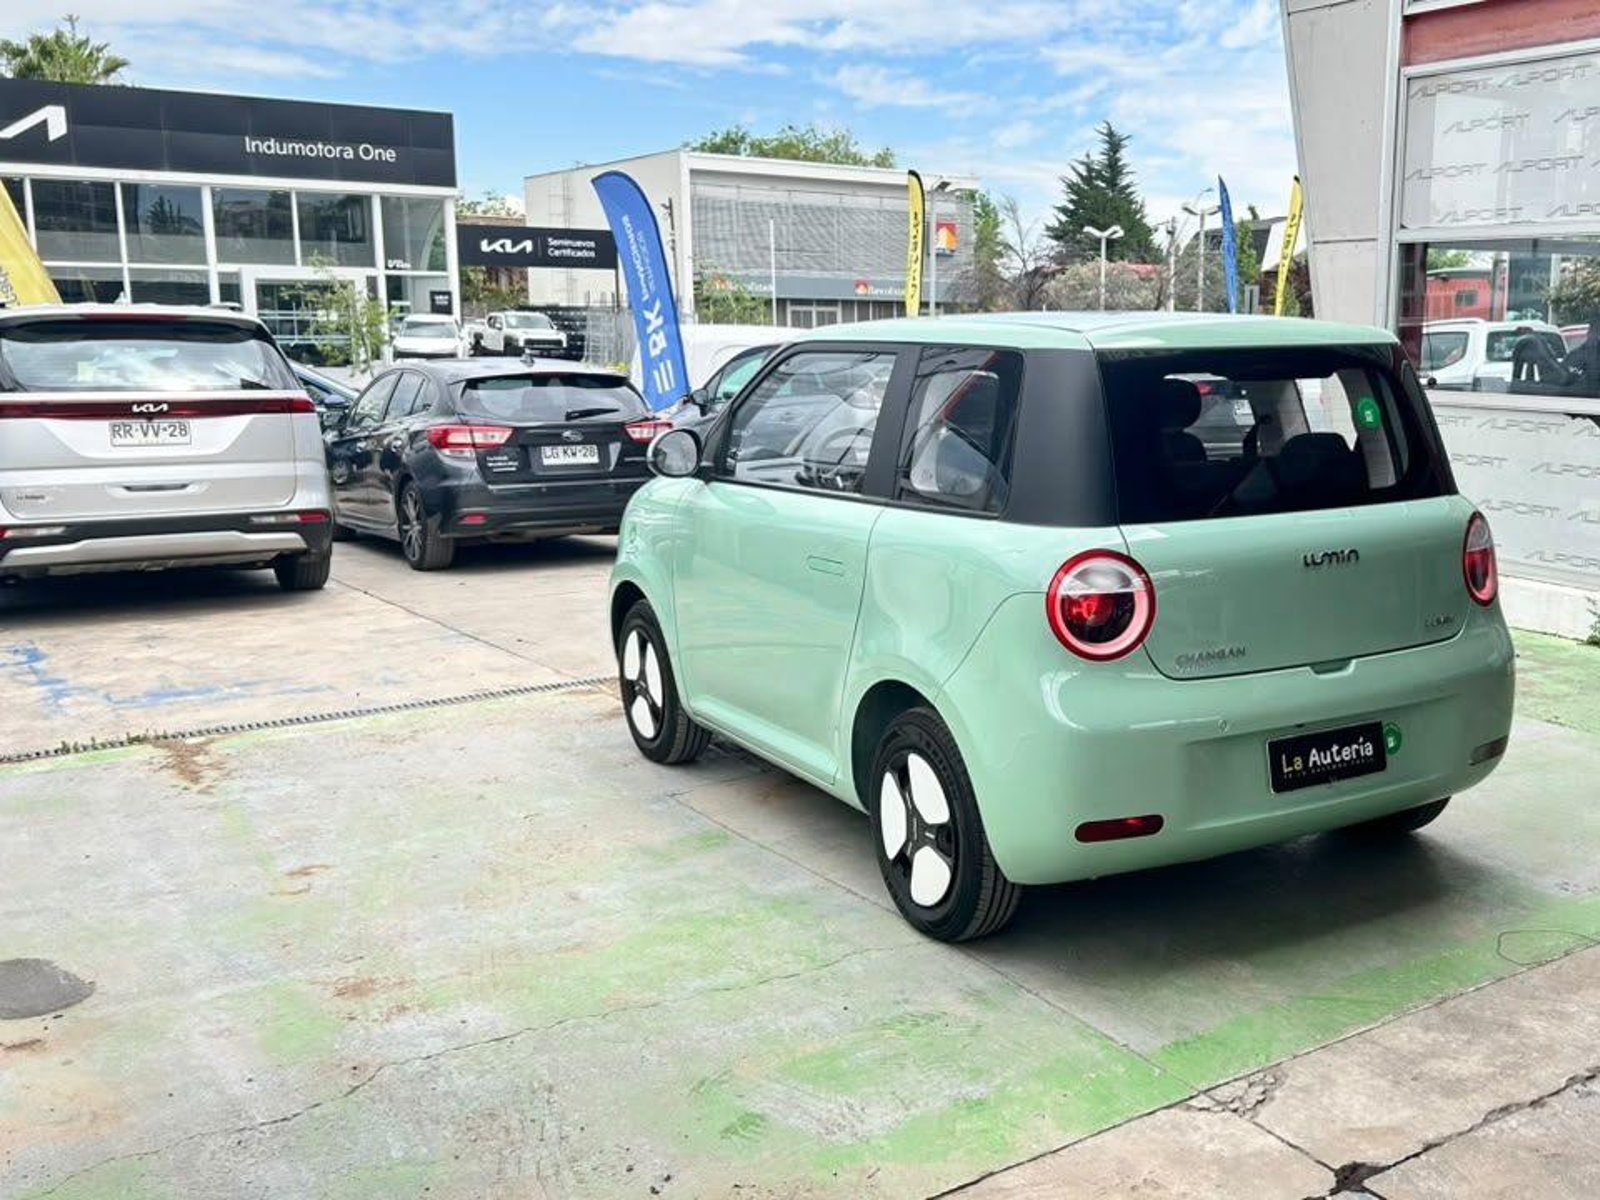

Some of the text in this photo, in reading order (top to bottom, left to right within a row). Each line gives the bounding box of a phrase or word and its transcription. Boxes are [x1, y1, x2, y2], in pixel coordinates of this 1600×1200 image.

[244, 136, 397, 162] Indumotora One
[1282, 753, 1303, 773] La
[1308, 735, 1374, 768] Autería
